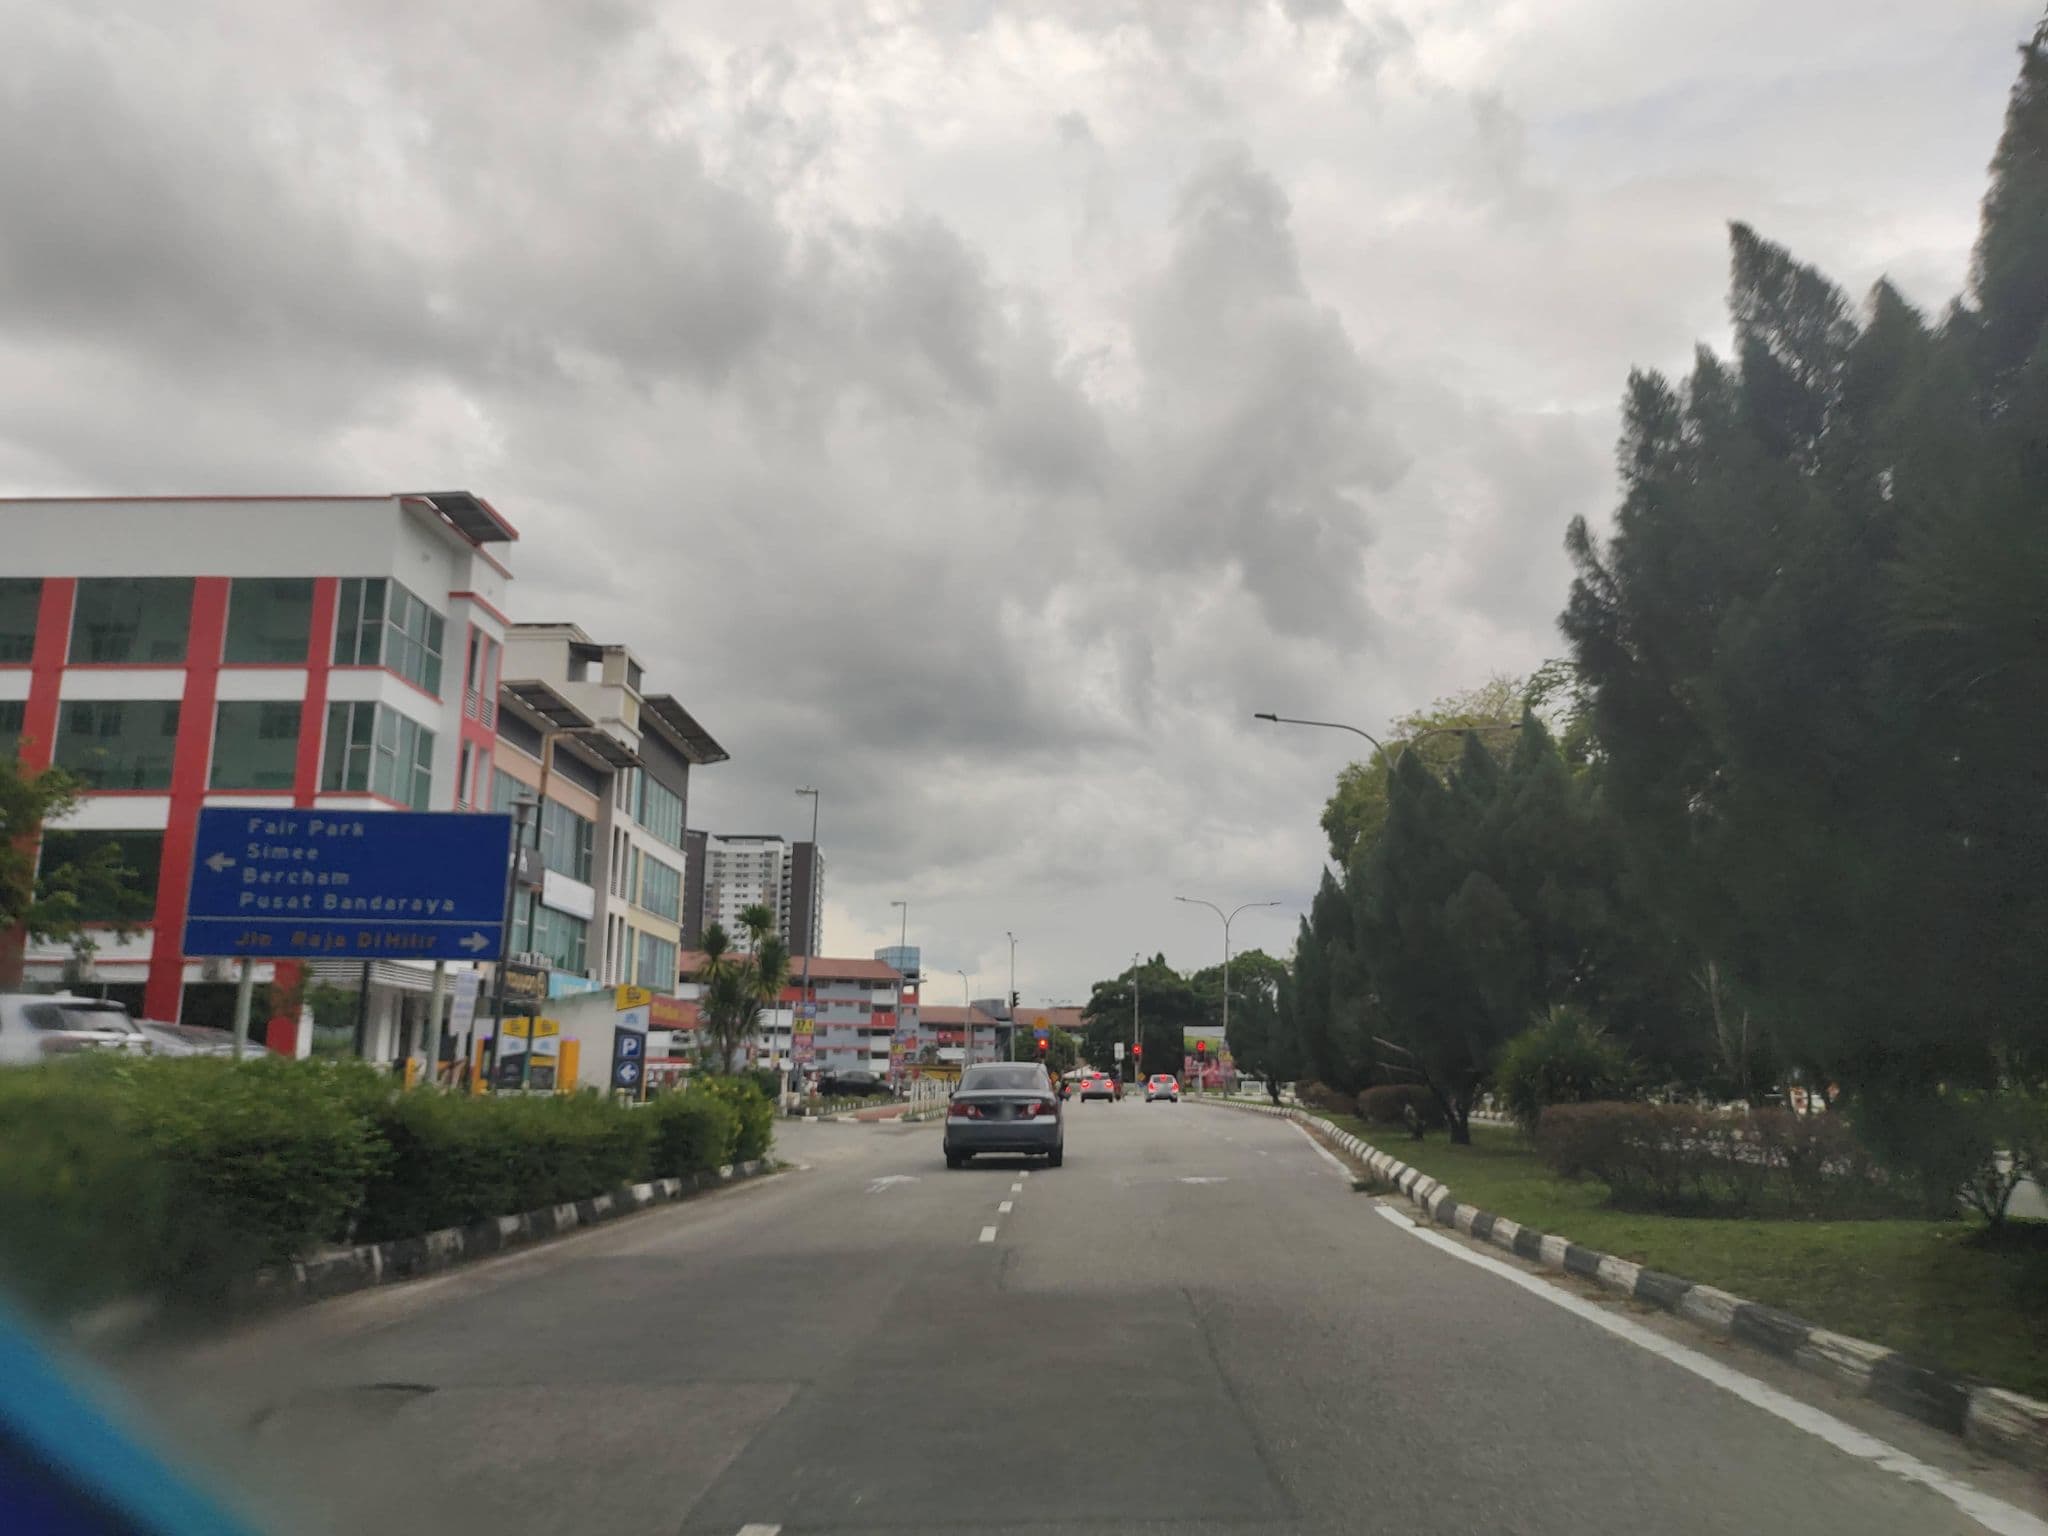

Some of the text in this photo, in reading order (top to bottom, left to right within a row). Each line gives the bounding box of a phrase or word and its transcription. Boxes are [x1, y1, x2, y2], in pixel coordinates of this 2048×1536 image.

[248, 817, 365, 838] Fair Park
[247, 841, 320, 860] Simee
[242, 866, 350, 886] Bercham
[239, 890, 456, 915] Pusat Bandaraya
[622, 1037, 638, 1056] P
